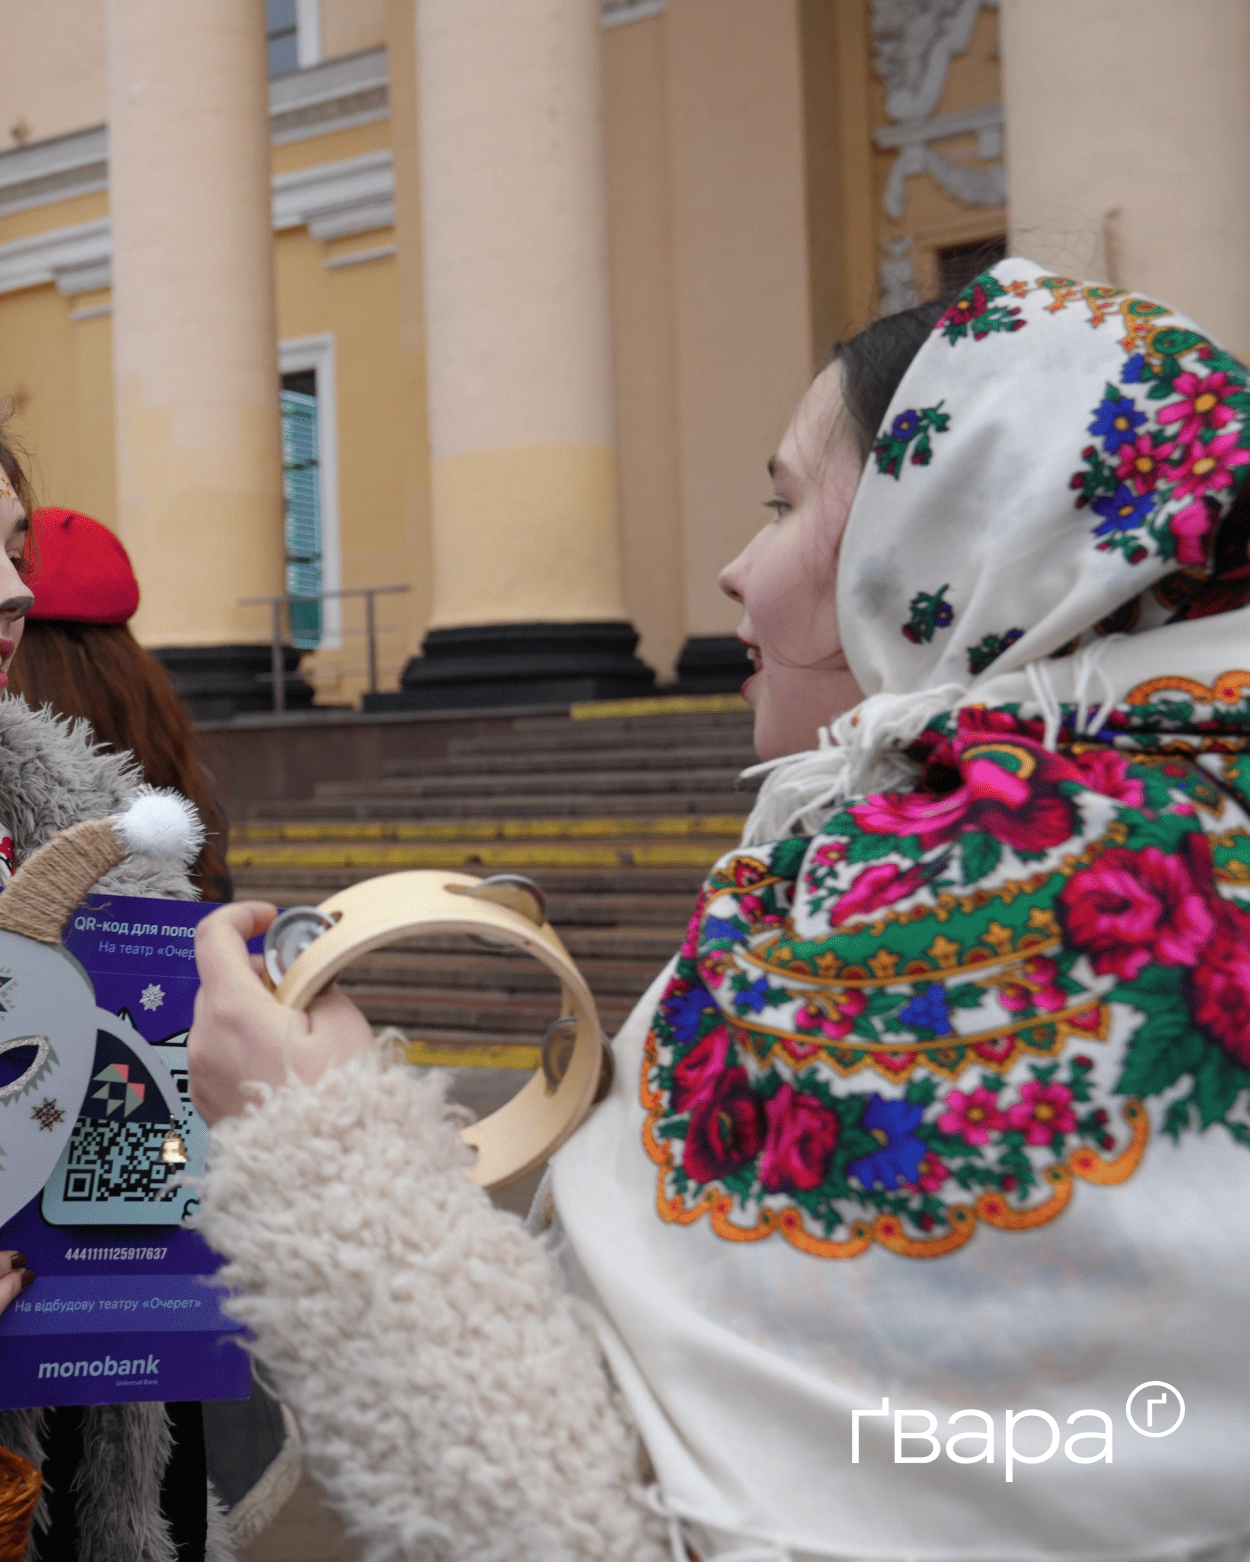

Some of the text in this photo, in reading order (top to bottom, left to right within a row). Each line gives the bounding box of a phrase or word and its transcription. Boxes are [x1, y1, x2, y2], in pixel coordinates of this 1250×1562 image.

[74, 916, 129, 935] QR-код
[131, 923, 158, 936] для
[98, 940, 116, 953] На
[119, 944, 154, 957] театр
[64, 1247, 168, 1260] 4441111125917637
[15, 1297, 202, 1314] На відбудову театру «Очерет»
[38, 1354, 161, 1378] monobank
